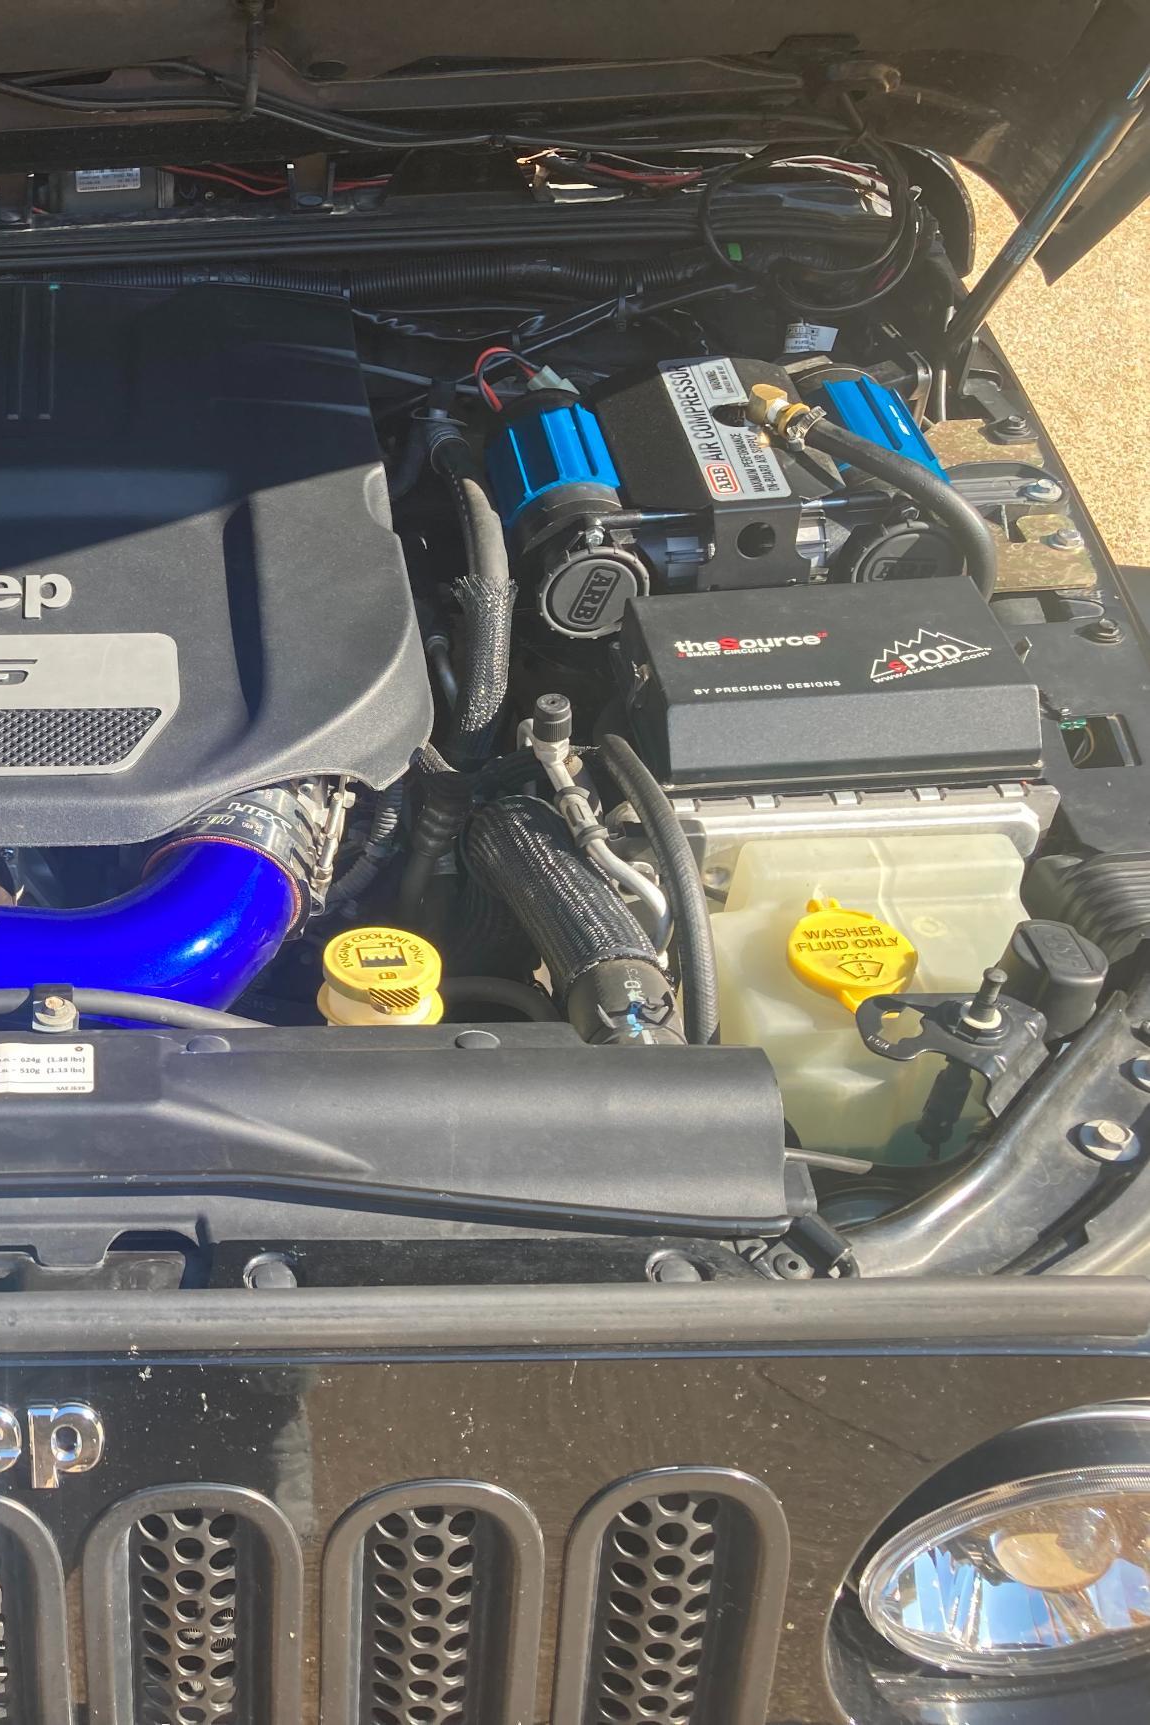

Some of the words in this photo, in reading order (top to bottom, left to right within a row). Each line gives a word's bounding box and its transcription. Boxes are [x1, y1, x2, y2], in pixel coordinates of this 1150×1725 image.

[667, 364, 716, 440] COMPRESSOR
[698, 441, 726, 461] AIR
[730, 433, 754, 468] PERFORMANCE
[745, 434, 764, 454] SUPPLY
[754, 453, 767, 464] AIR
[714, 467, 732, 490] ARB
[747, 468, 765, 493] MAXIMUM
[760, 464, 780, 492] ON-BOARD
[574, 572, 614, 618] ARB
[674, 634, 821, 653] theSource
[686, 650, 721, 658] SMART
[724, 647, 771, 655] CIRCUITS
[715, 684, 782, 694] PRECISION
[787, 680, 841, 690] DESIGNS
[802, 926, 883, 940] WASHER
[338, 942, 354, 968] ENGINE
[351, 932, 410, 945] COOLANT
[409, 944, 426, 966] ONLY
[796, 939, 848, 952] FLUID
[852, 937, 899, 949] ONLY
